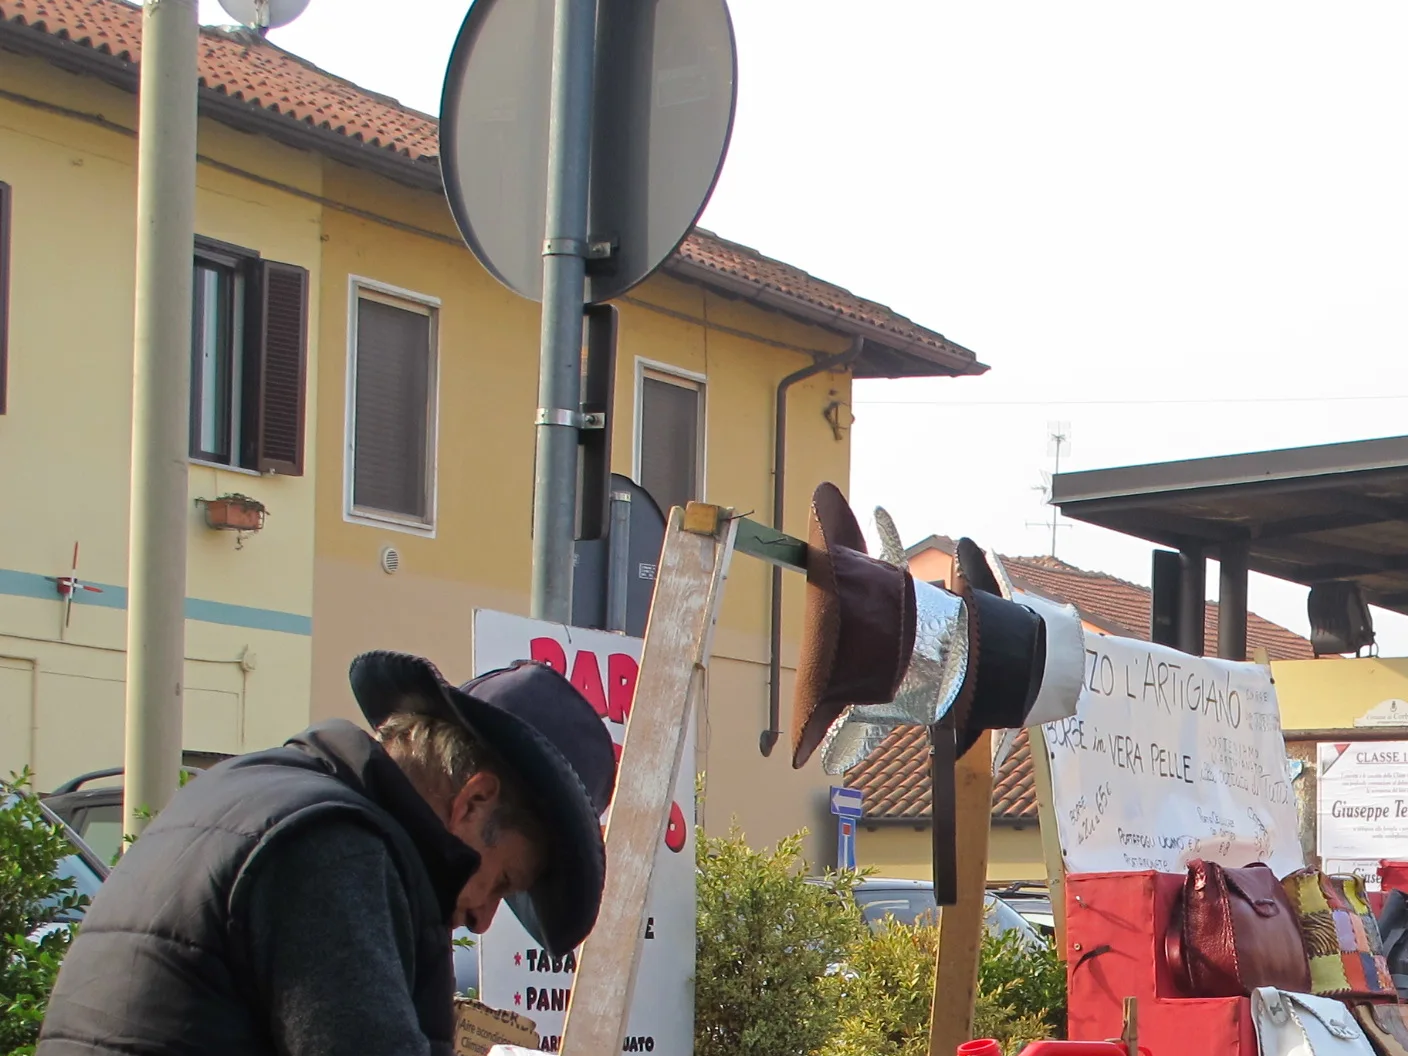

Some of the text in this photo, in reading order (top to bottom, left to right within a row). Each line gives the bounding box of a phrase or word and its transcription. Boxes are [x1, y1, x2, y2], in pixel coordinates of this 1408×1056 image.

[1081, 648, 1240, 729] ZO L'ARTIGIANO
[1108, 733, 1145, 775] VERA
[1150, 743, 1194, 784] PELLE
[1356, 752, 1399, 763] CLASSE
[1332, 800, 1389, 821] Giuseppe
